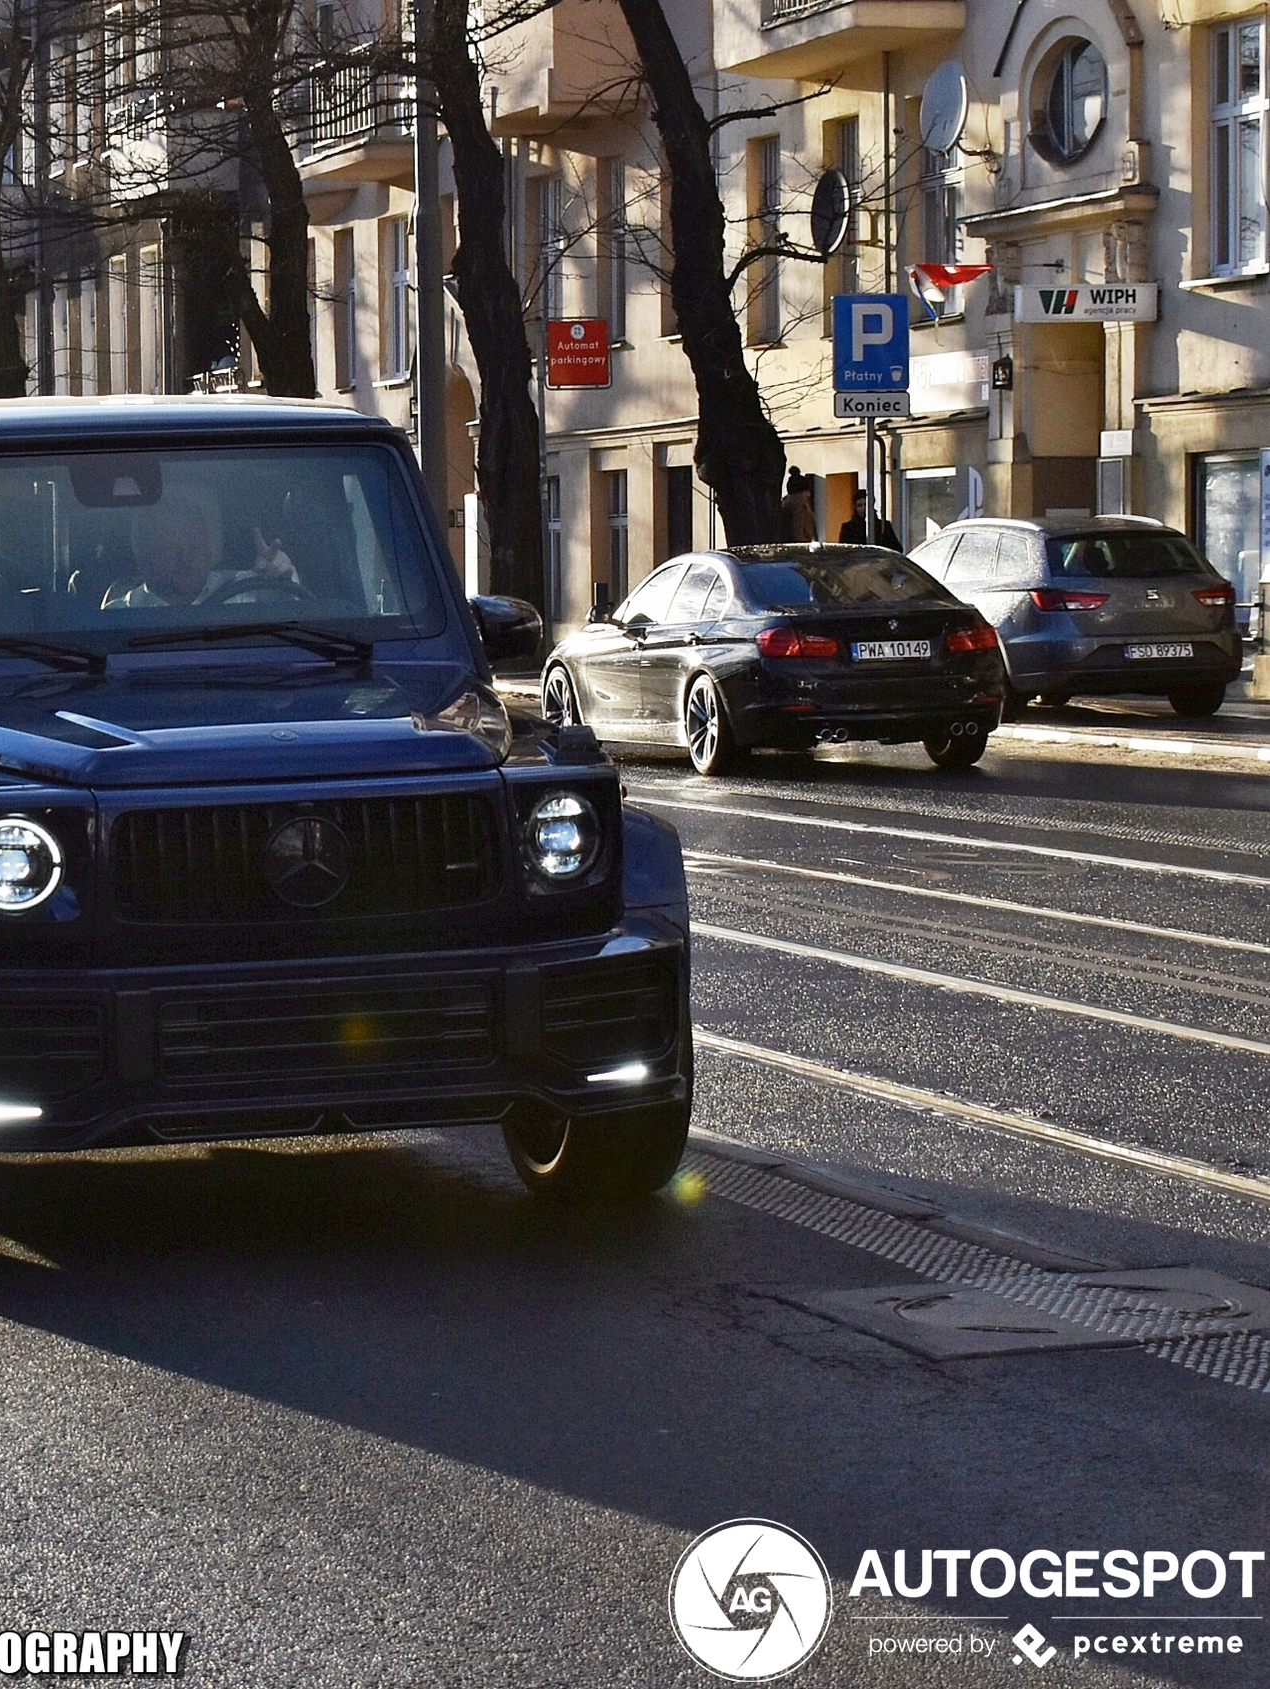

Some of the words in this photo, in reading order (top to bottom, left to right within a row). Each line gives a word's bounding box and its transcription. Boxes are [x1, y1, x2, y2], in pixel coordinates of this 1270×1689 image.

[1090, 289, 1136, 304] WIPH
[1084, 306, 1113, 316] agencja
[1116, 306, 1136, 315] pracy
[852, 303, 894, 362] P
[557, 341, 599, 351] Automat
[550, 355, 606, 367] parkingowy
[844, 370, 883, 384] Płatny
[843, 397, 901, 412] Koniec
[859, 643, 885, 658] PWA
[890, 641, 929, 657] 10149
[1130, 644, 1153, 658] FSD
[1155, 643, 1191, 657] 89375
